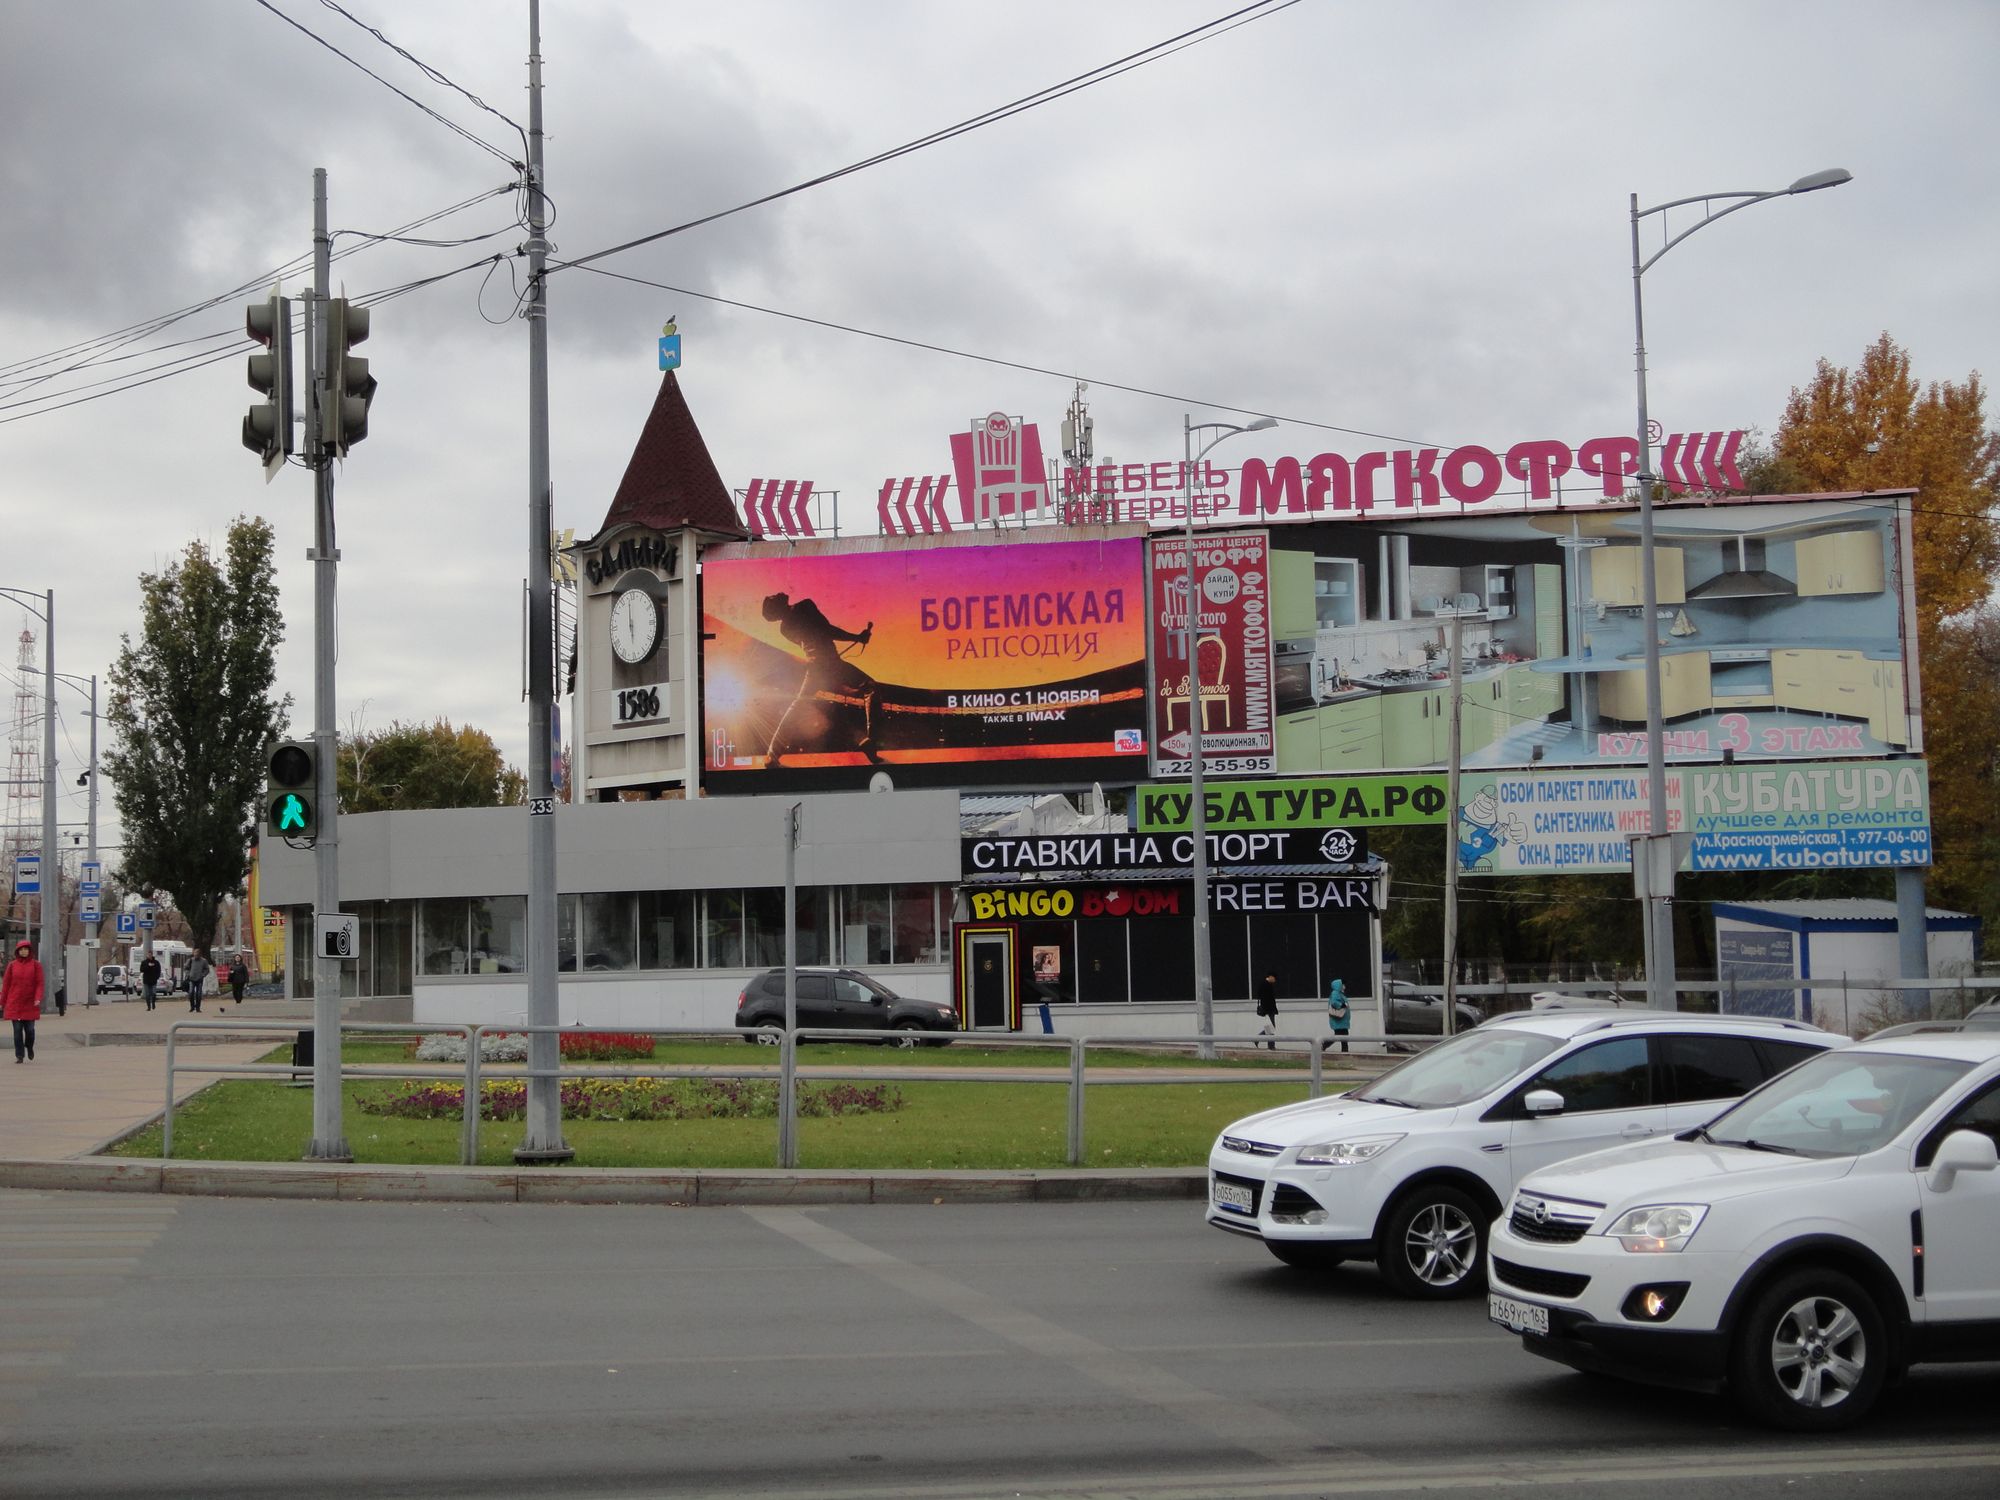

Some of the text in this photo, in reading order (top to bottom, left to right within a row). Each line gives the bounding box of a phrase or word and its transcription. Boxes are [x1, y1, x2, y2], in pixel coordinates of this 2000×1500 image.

[1064, 459, 1229, 496] МЕБЕЛЬ
[1238, 436, 1640, 516] МЯГКОФФ
[1065, 493, 1231, 525] ИНТЕРЬЕР
[1155, 537, 1262, 551] МЕБЕЬНЫЙ ЦЕНТР
[1207, 575, 1234, 583] ЗАЙДИ
[1213, 590, 1235, 598] КУПИ
[921, 589, 1124, 632] БОГЕМСКАЯ
[946, 632, 1099, 662] РАПСОДИЯ
[617, 686, 660, 721] 1586
[947, 690, 1099, 708] В КИНО С 1 НОЯБРЯ
[983, 710, 1065, 723] ТАКЖЕ В IMAX
[711, 727, 736, 768] 18+
[1718, 713, 1752, 753] 3
[1760, 725, 1864, 752] ЭТАЖ
[1144, 784, 1446, 826] КУБАТУРА.РФ
[1501, 782, 1533, 803] ОБОИ
[1538, 780, 1584, 803] ПАРКЕТ
[1588, 779, 1637, 801] ПЛИТКА
[1693, 767, 1923, 815] КУБАТУРА
[530, 799, 553, 815] 233
[1534, 809, 1682, 834] САНТЕХНИКА ИНТЕЕР
[1696, 810, 1923, 832] лучшее для ремонта
[972, 832, 1290, 869] СТАВКИ НА СПОРТ
[1329, 836, 1348, 850] 24
[1518, 844, 1551, 866] ОКНА
[1554, 843, 1595, 868] ДВЕРИ
[1697, 847, 1928, 868] www.kubatura.su
[1081, 887, 1179, 917] BOOM
[1297, 880, 1370, 909] BAR
